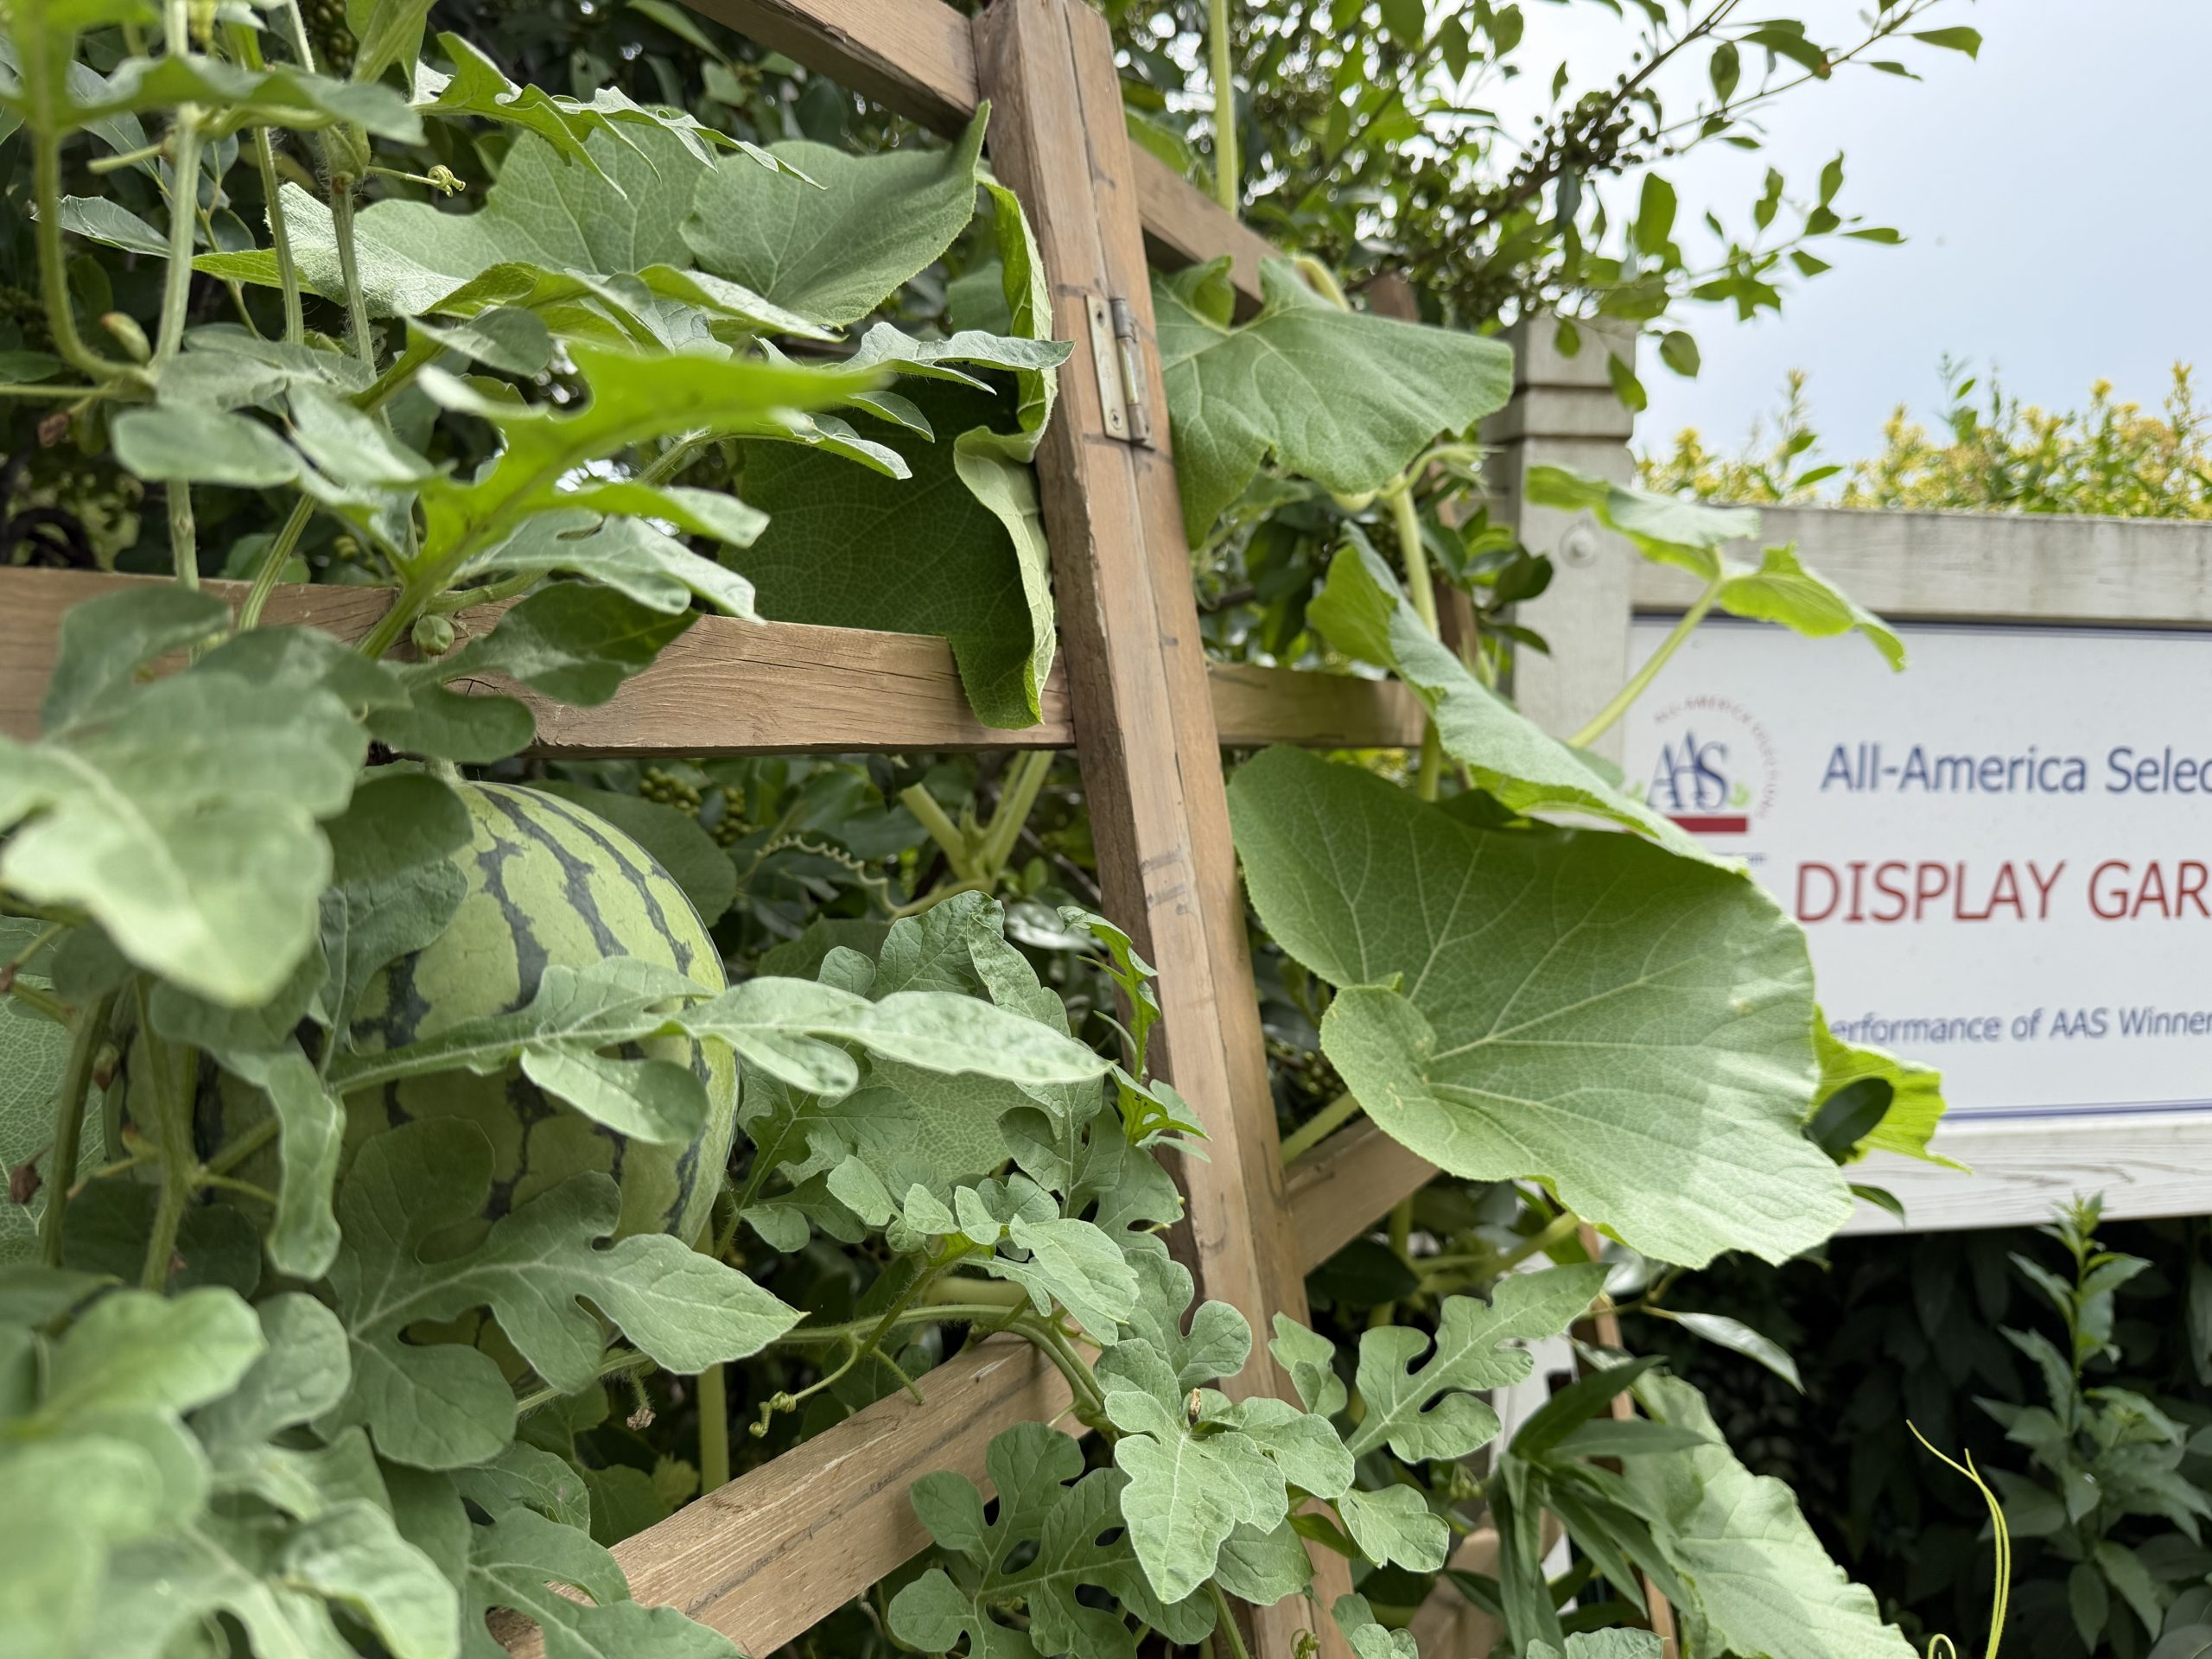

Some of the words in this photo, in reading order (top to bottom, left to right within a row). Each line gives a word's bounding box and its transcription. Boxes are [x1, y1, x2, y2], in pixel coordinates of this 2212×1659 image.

[1645, 730, 1730, 813] AAS
[1821, 742, 2087, 793] All-America
[1796, 861, 2067, 923] DISPLAY
[2088, 860, 2212, 920] GAR
[1829, 1012, 2001, 1044] erformance
[2012, 1008, 2043, 1039] of
[2050, 1007, 2107, 1039] AAS
